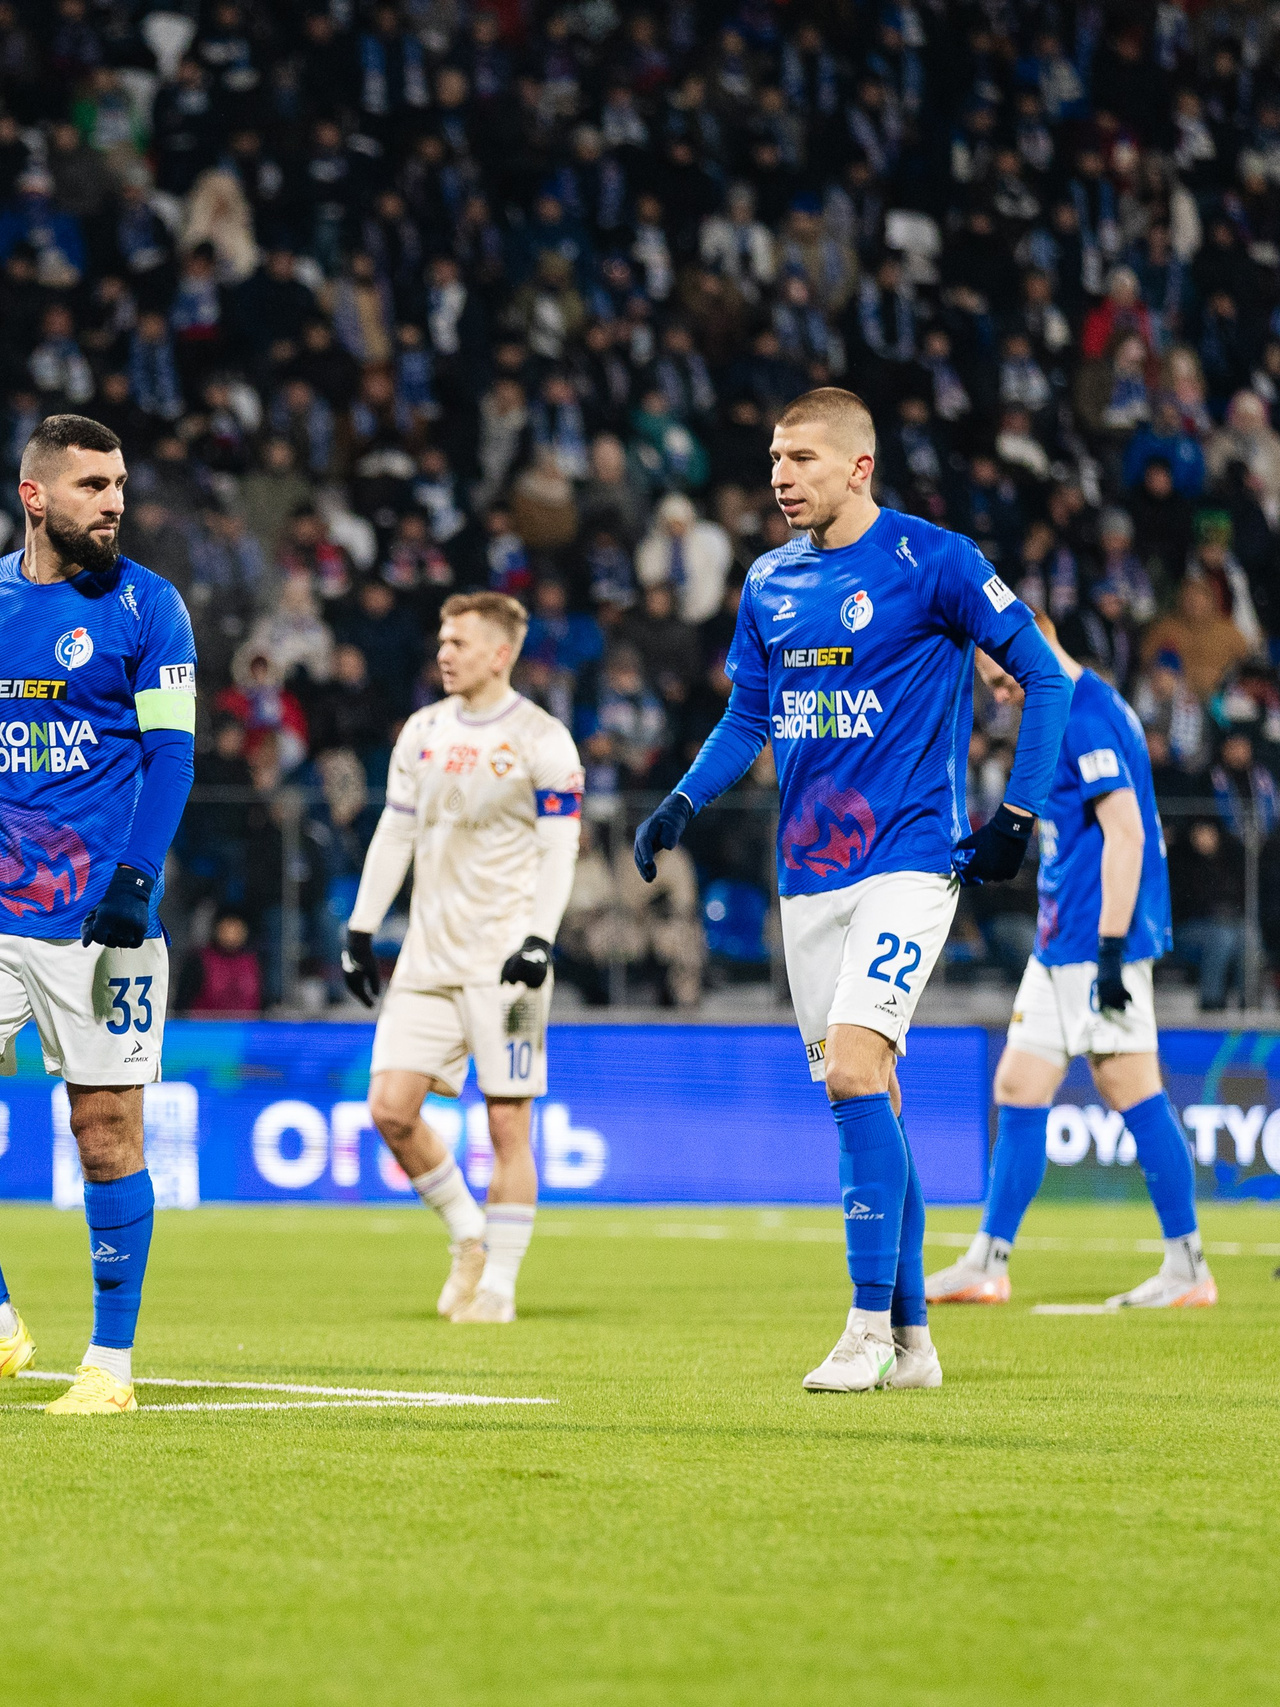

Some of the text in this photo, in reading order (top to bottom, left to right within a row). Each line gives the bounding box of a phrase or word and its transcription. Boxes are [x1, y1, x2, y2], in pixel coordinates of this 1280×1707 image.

[783, 647, 852, 668] МЕЛБЕТ
[782, 689, 883, 715] EKONIVA
[772, 714, 874, 739] ЭКОНИВА
[867, 932, 922, 994] 22
[106, 976, 153, 1035] 33
[123, 1056, 149, 1064] DEMIX
[506, 1041, 532, 1079] 10
